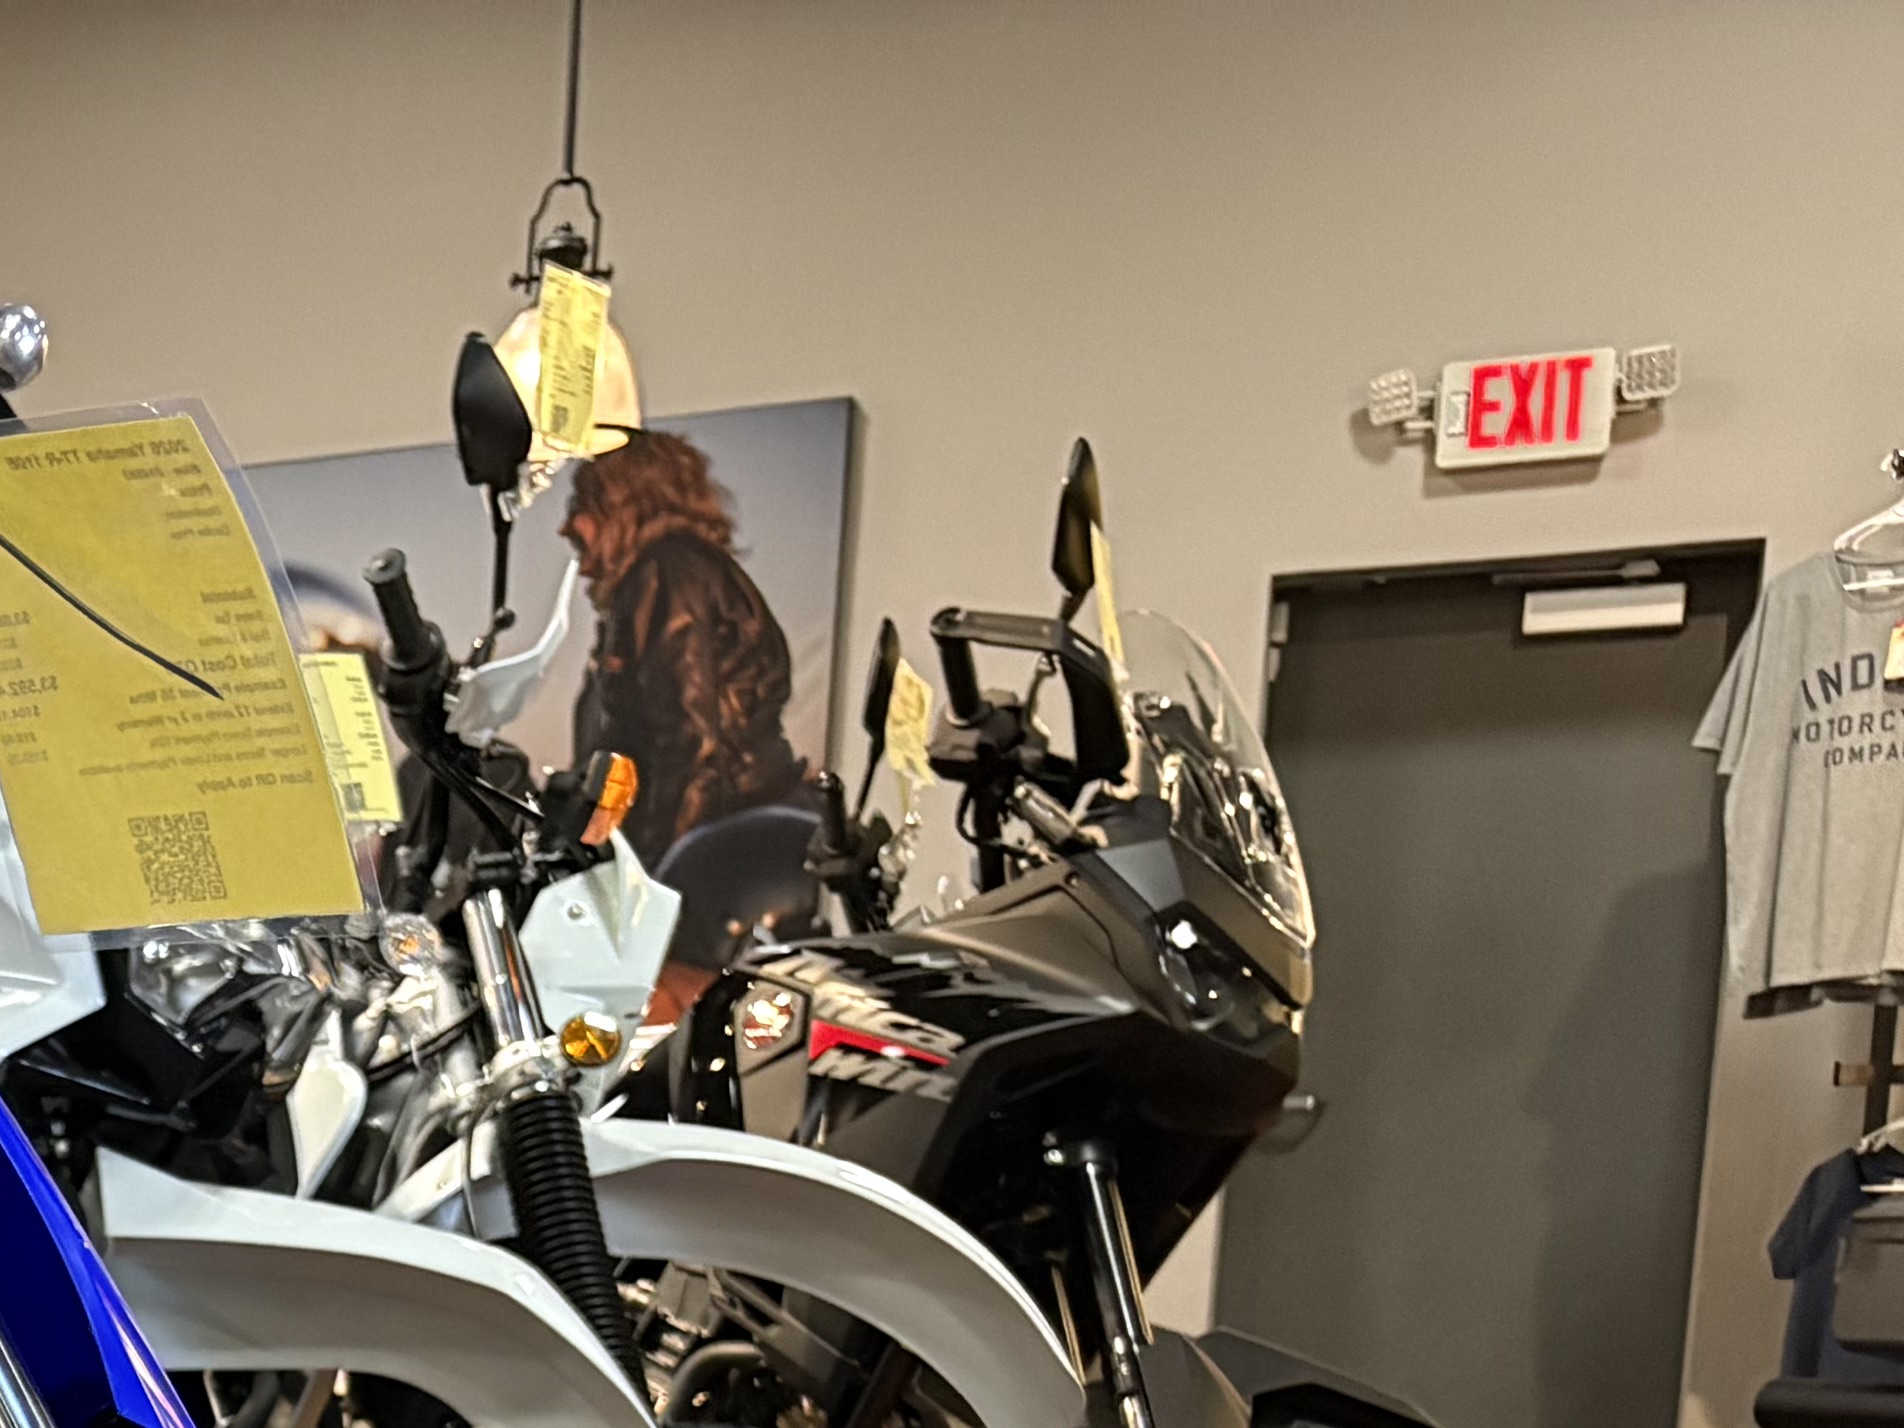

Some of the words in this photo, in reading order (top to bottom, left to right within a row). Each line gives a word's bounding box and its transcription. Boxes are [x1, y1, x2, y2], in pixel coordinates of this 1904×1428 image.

[1468, 355, 1594, 449] EXIT
[1801, 653, 1876, 711] IND
[1824, 740, 1904, 769] COMPA
